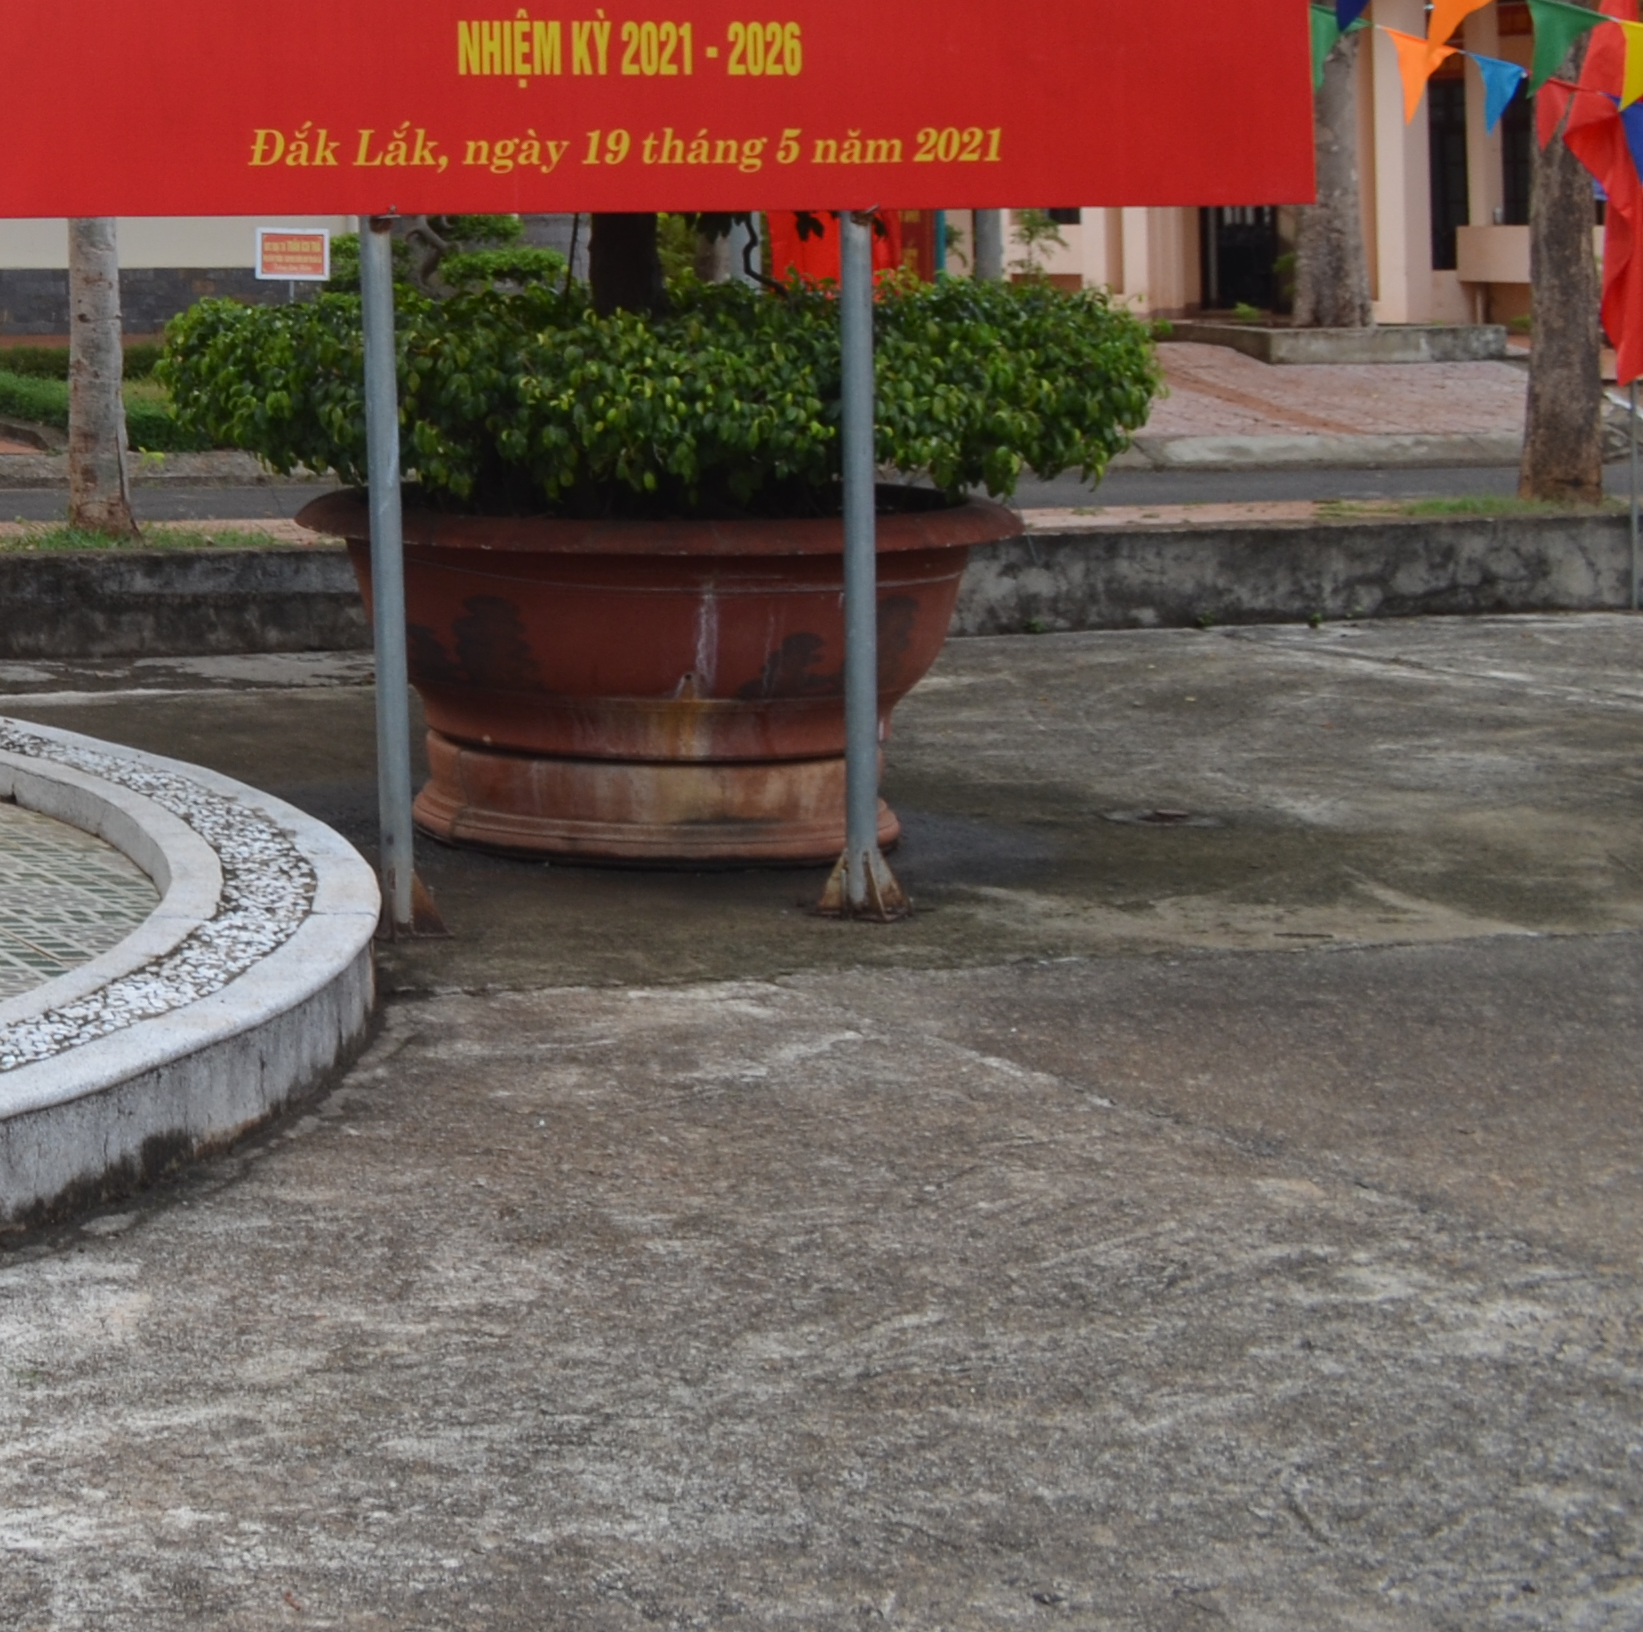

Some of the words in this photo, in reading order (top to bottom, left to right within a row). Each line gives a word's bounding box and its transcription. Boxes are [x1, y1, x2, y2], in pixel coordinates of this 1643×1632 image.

[457, 8, 562, 89] NHIỆM
[571, 9, 612, 76] KỲ
[621, 20, 693, 76] 2021
[706, 46, 719, 58] -
[727, 21, 803, 76] 2026
[250, 122, 338, 167] Đắk
[354, 121, 449, 169] Lắk,
[464, 129, 570, 174] ngày
[585, 129, 631, 165] 19
[642, 127, 767, 172] tháng
[776, 128, 801, 164] 5
[813, 130, 902, 164] năm
[913, 127, 1001, 162] 2021
